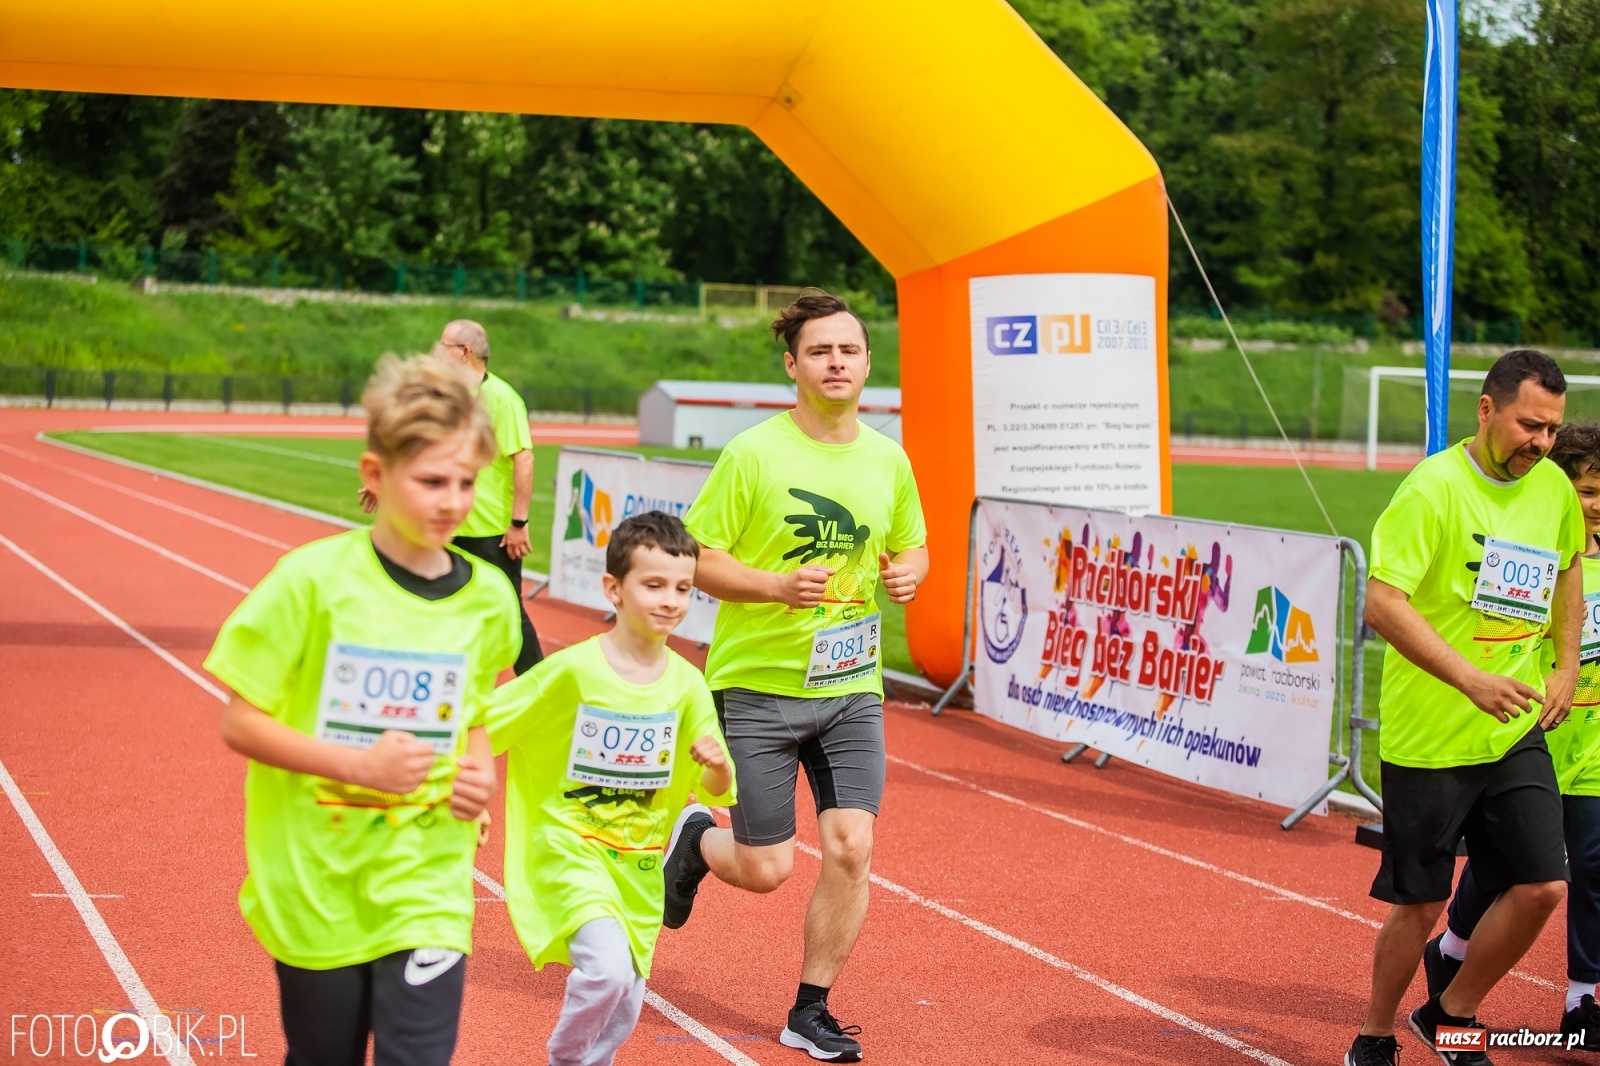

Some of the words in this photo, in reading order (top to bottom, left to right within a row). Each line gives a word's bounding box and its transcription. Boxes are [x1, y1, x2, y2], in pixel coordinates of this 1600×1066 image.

[1010, 403, 1041, 412] Projekt
[1010, 464, 1072, 474] Europejskiego
[1002, 485, 1061, 494] Regionalnego
[817, 520, 838, 540] VI
[837, 533, 854, 541] BIEG
[816, 541, 828, 549] BEZ
[829, 541, 854, 550] BARIER
[1069, 544, 1203, 625] Raciborski
[1503, 560, 1541, 589] 003
[831, 634, 864, 661] 081
[1041, 605, 1088, 687] Bieg
[1091, 616, 1135, 682] bez
[1138, 630, 1226, 706] Barier
[364, 666, 432, 701] 008
[603, 726, 656, 752] 078
[1185, 728, 1262, 768] opiekunów
